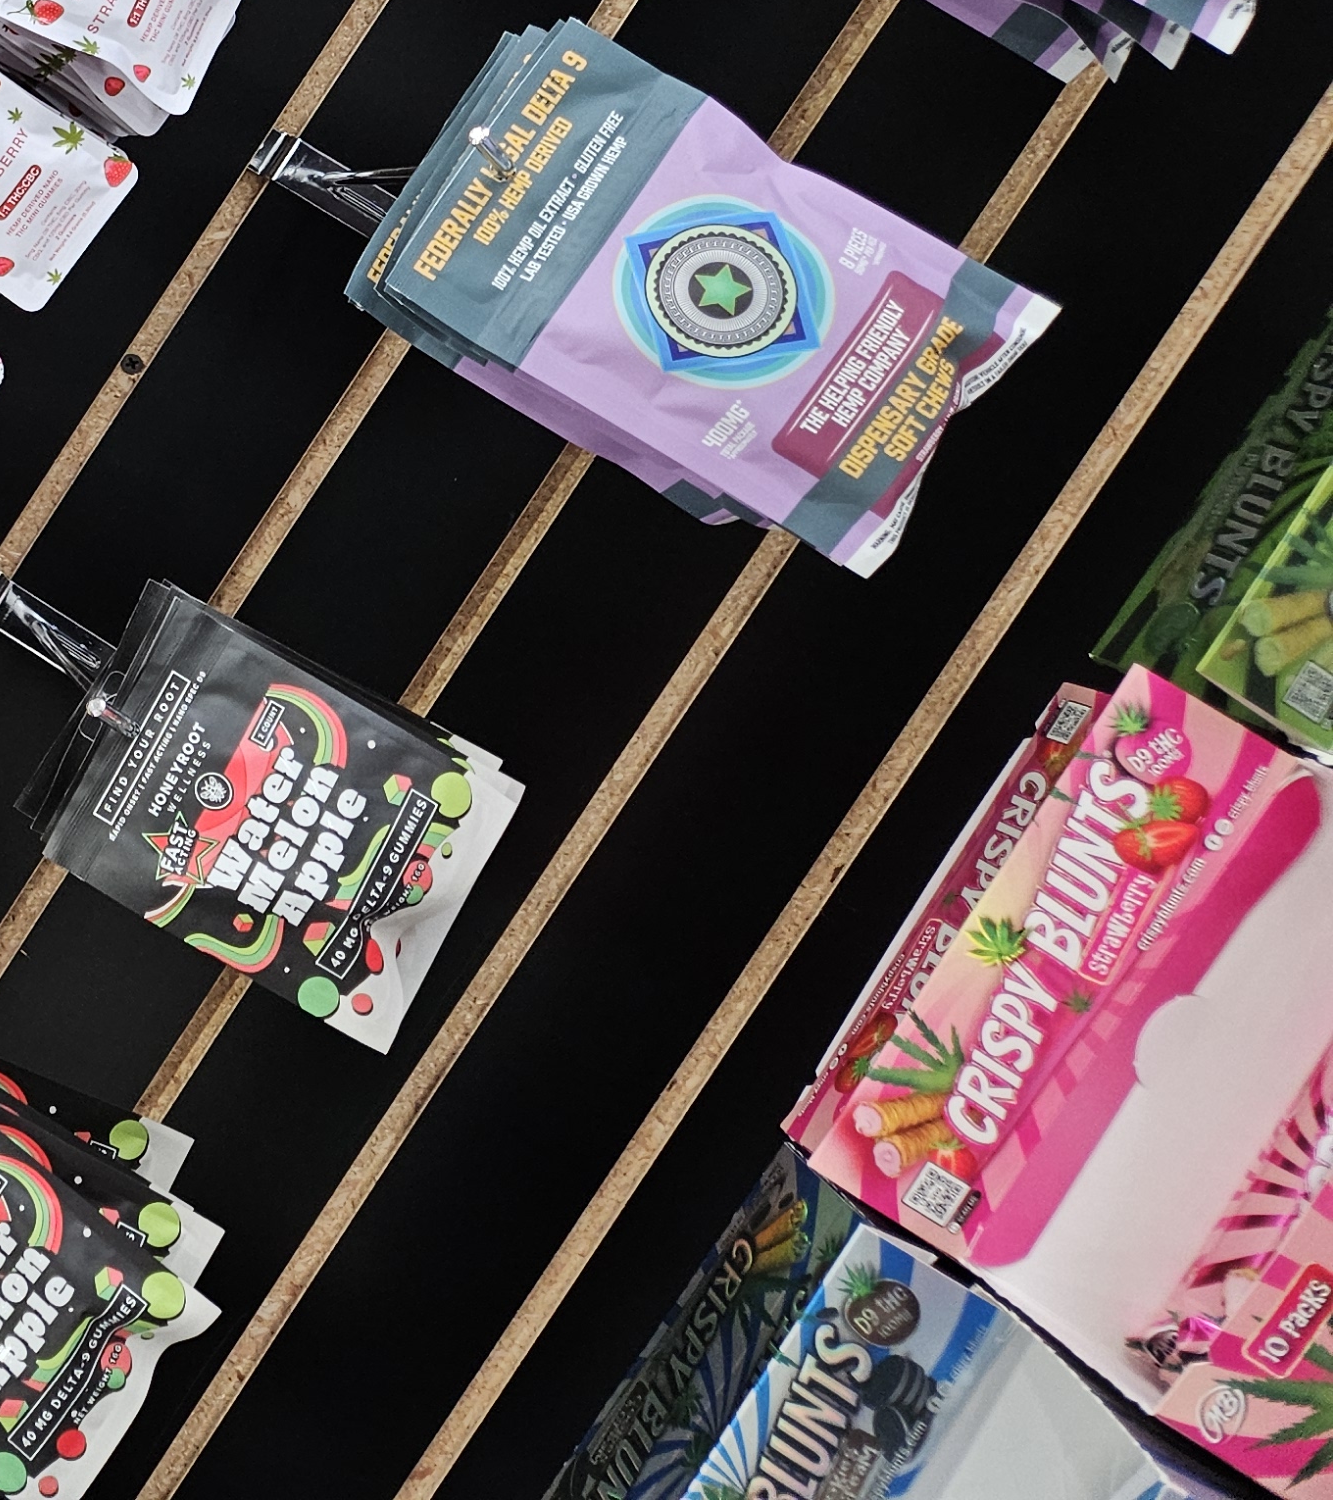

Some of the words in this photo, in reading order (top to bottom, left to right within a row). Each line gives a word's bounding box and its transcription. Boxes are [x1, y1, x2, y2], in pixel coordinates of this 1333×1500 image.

[412, 177, 498, 282] FEDERALLY
[518, 63, 576, 127] DELTA
[559, 47, 588, 72] 9
[800, 405, 831, 437] THE
[818, 353, 867, 412] HELPING
[853, 298, 906, 361] FRIENDLY
[831, 386, 870, 429] HEMP
[856, 324, 913, 393] COMPANY
[838, 369, 930, 480] DISPENSARY
[912, 314, 964, 375] GRADE
[882, 413, 928, 463] SOFT
[912, 356, 961, 421] CHEWS
[102, 774, 130, 813] FIND
[126, 727, 156, 769] YOUR
[152, 679, 182, 723] ROOT
[146, 721, 206, 817] HONEYROOT
[167, 740, 212, 813] WELLNESS
[157, 820, 191, 873] FAST
[172, 828, 199, 876] ACTING
[205, 744, 309, 897] Water
[237, 760, 341, 915] Melon
[271, 782, 376, 931] Apple
[936, 958, 1071, 1150] CRISPY
[1020, 753, 1156, 971] BLUNTS
[1257, 1334, 1291, 1363] 10
